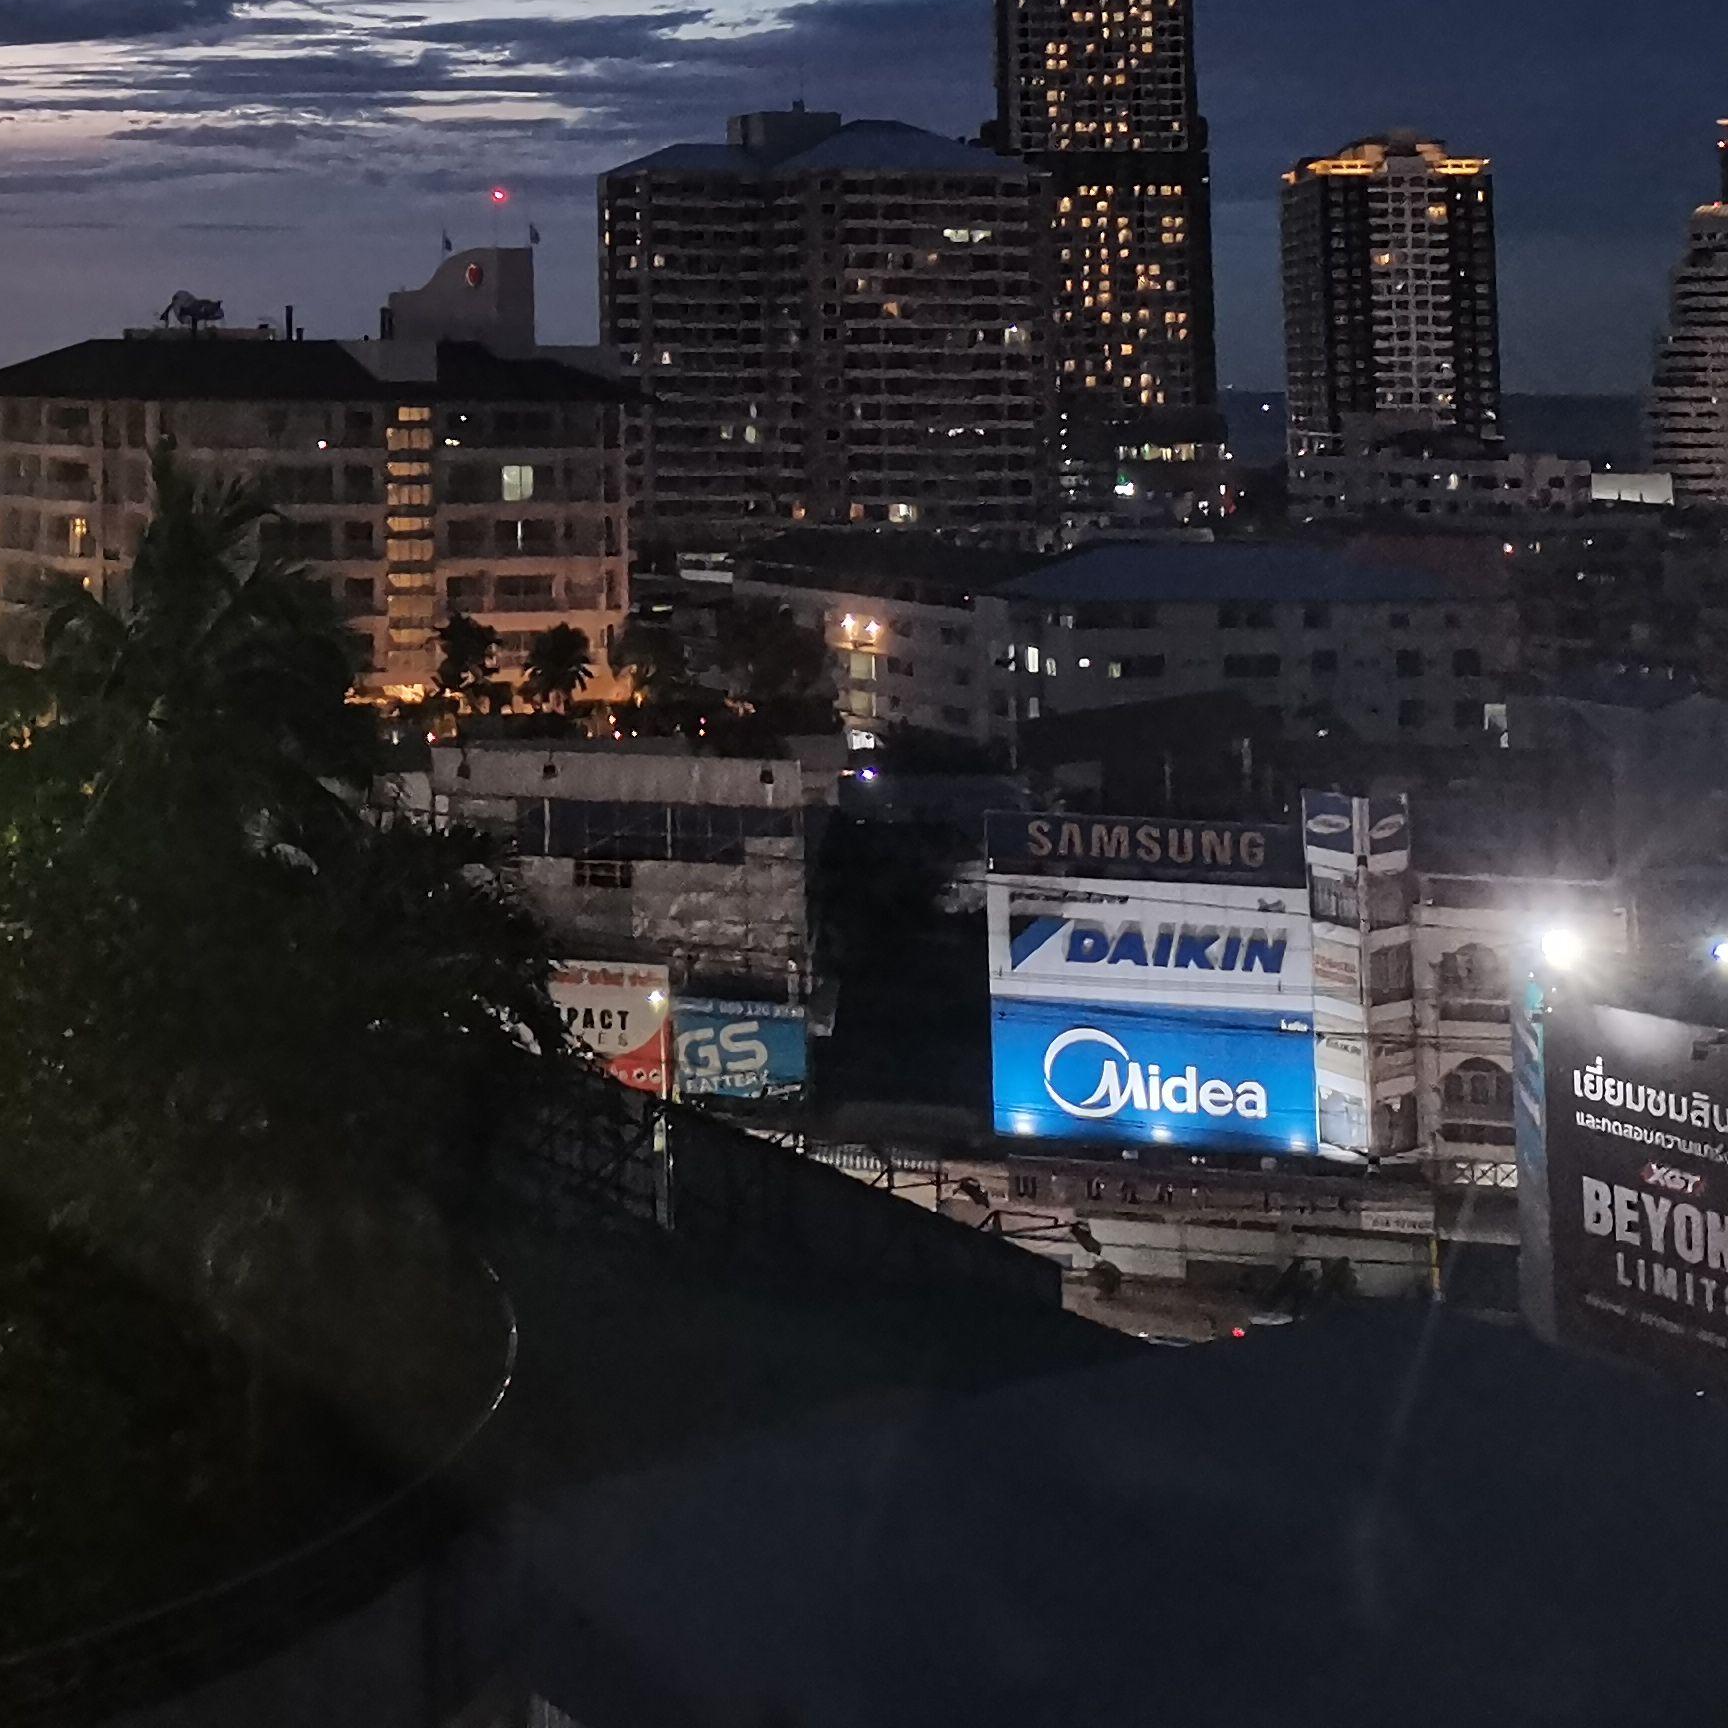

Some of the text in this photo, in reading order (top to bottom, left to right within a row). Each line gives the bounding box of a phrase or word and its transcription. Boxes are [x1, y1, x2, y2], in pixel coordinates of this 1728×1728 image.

[1027, 820, 1266, 868] SAMSUNG
[1065, 925, 1288, 974] DAIKIN
[677, 1020, 769, 1077] GS
[1079, 1058, 1268, 1120] Midea
[1616, 1251, 1728, 1314] LIMIT
